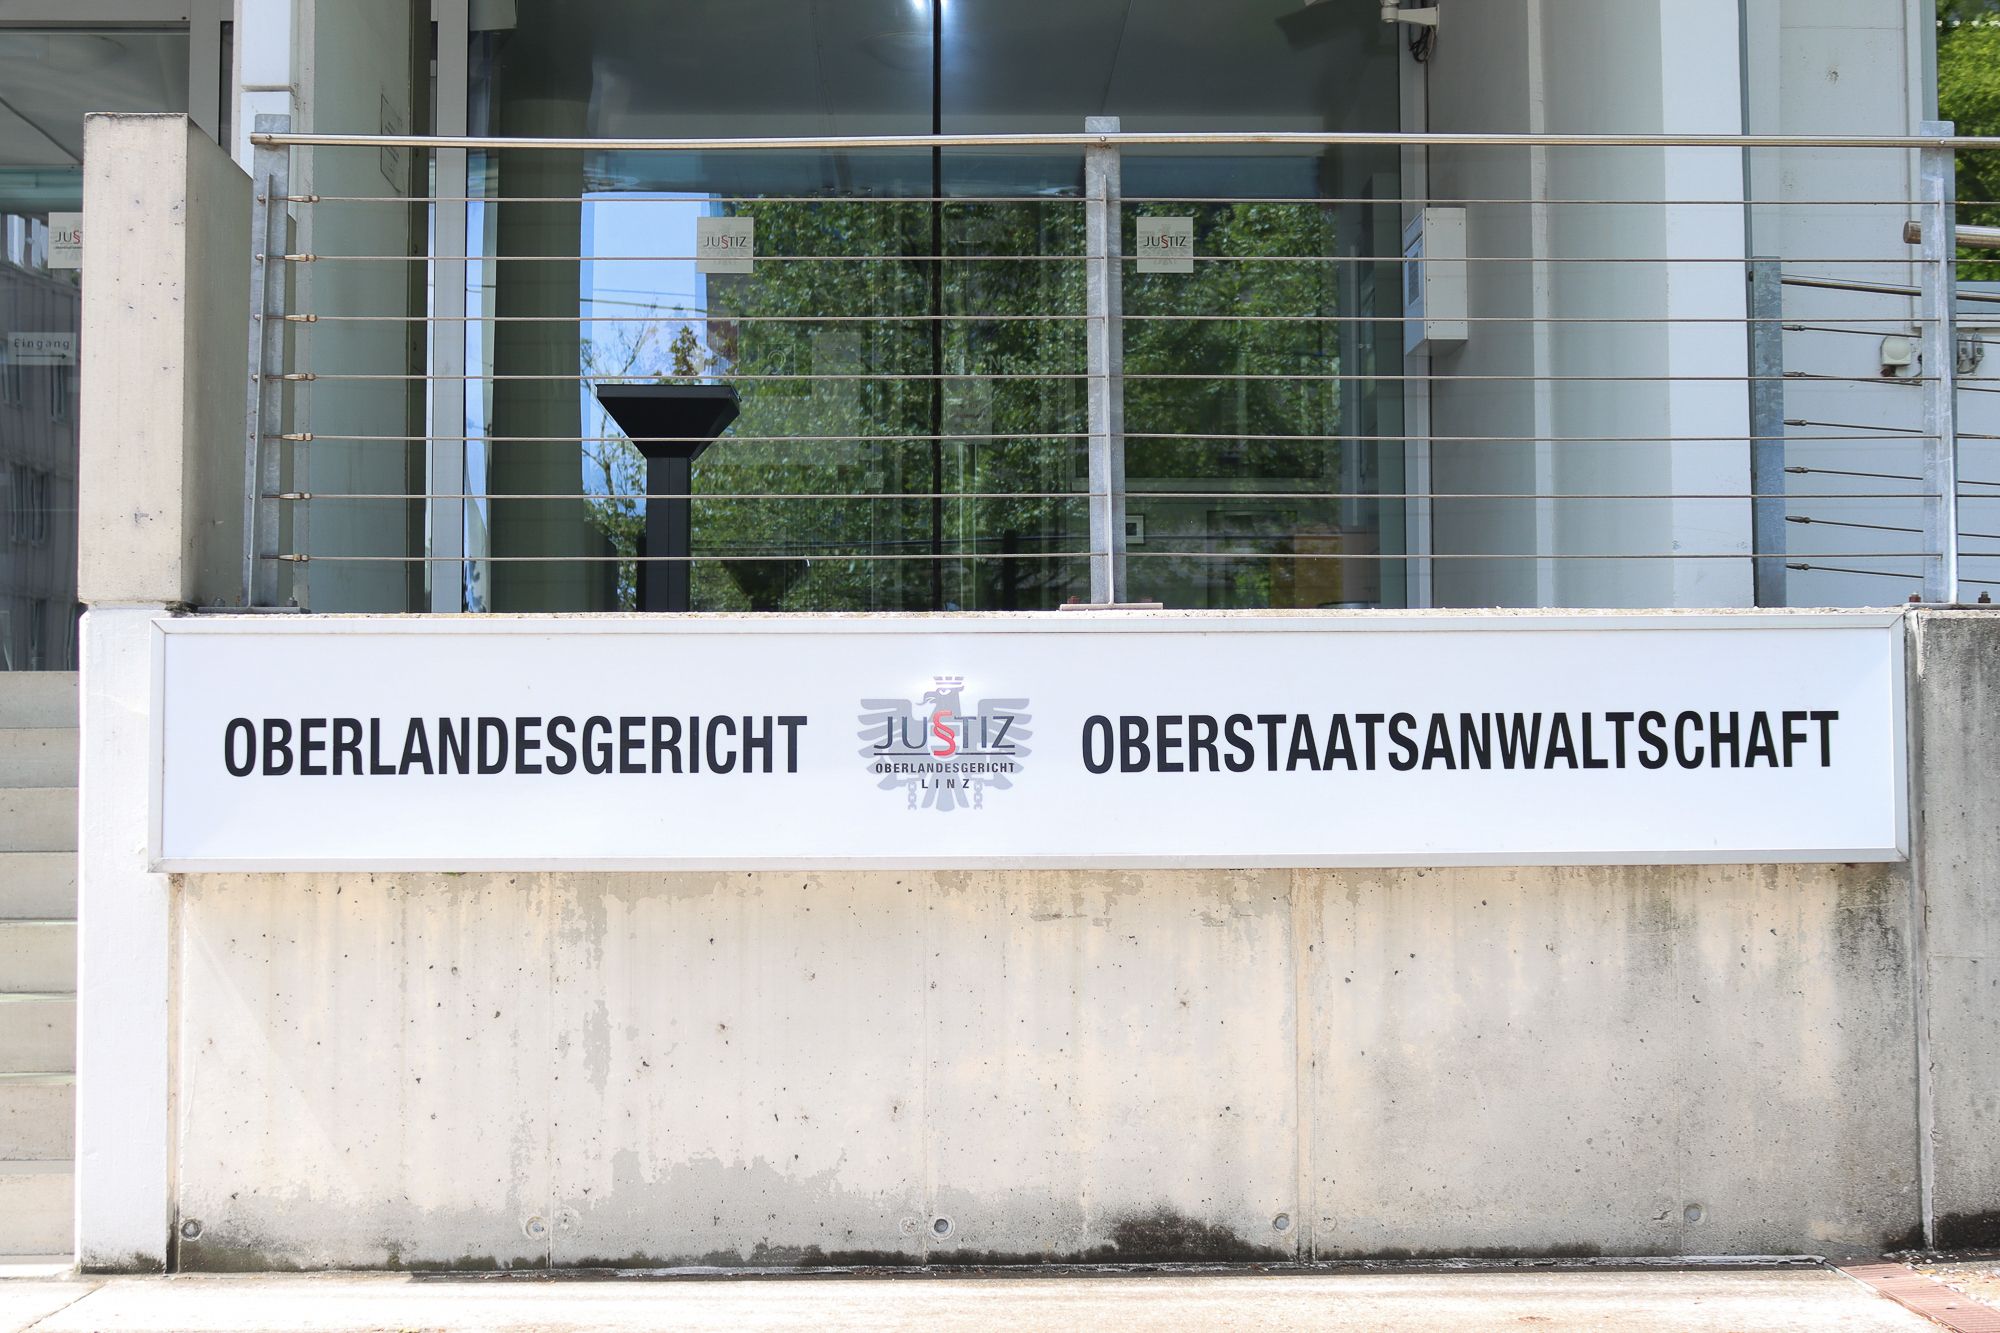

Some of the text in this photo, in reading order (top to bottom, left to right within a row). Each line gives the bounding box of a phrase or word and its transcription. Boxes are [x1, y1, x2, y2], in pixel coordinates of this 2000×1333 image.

[14, 338, 70, 351] Eingang
[225, 714, 808, 778] OBERLANDESGERICHT
[1082, 710, 1839, 775] OBERSTAATSANWALTSCHAFT
[875, 762, 1015, 774] OBERLANDESGERICHT
